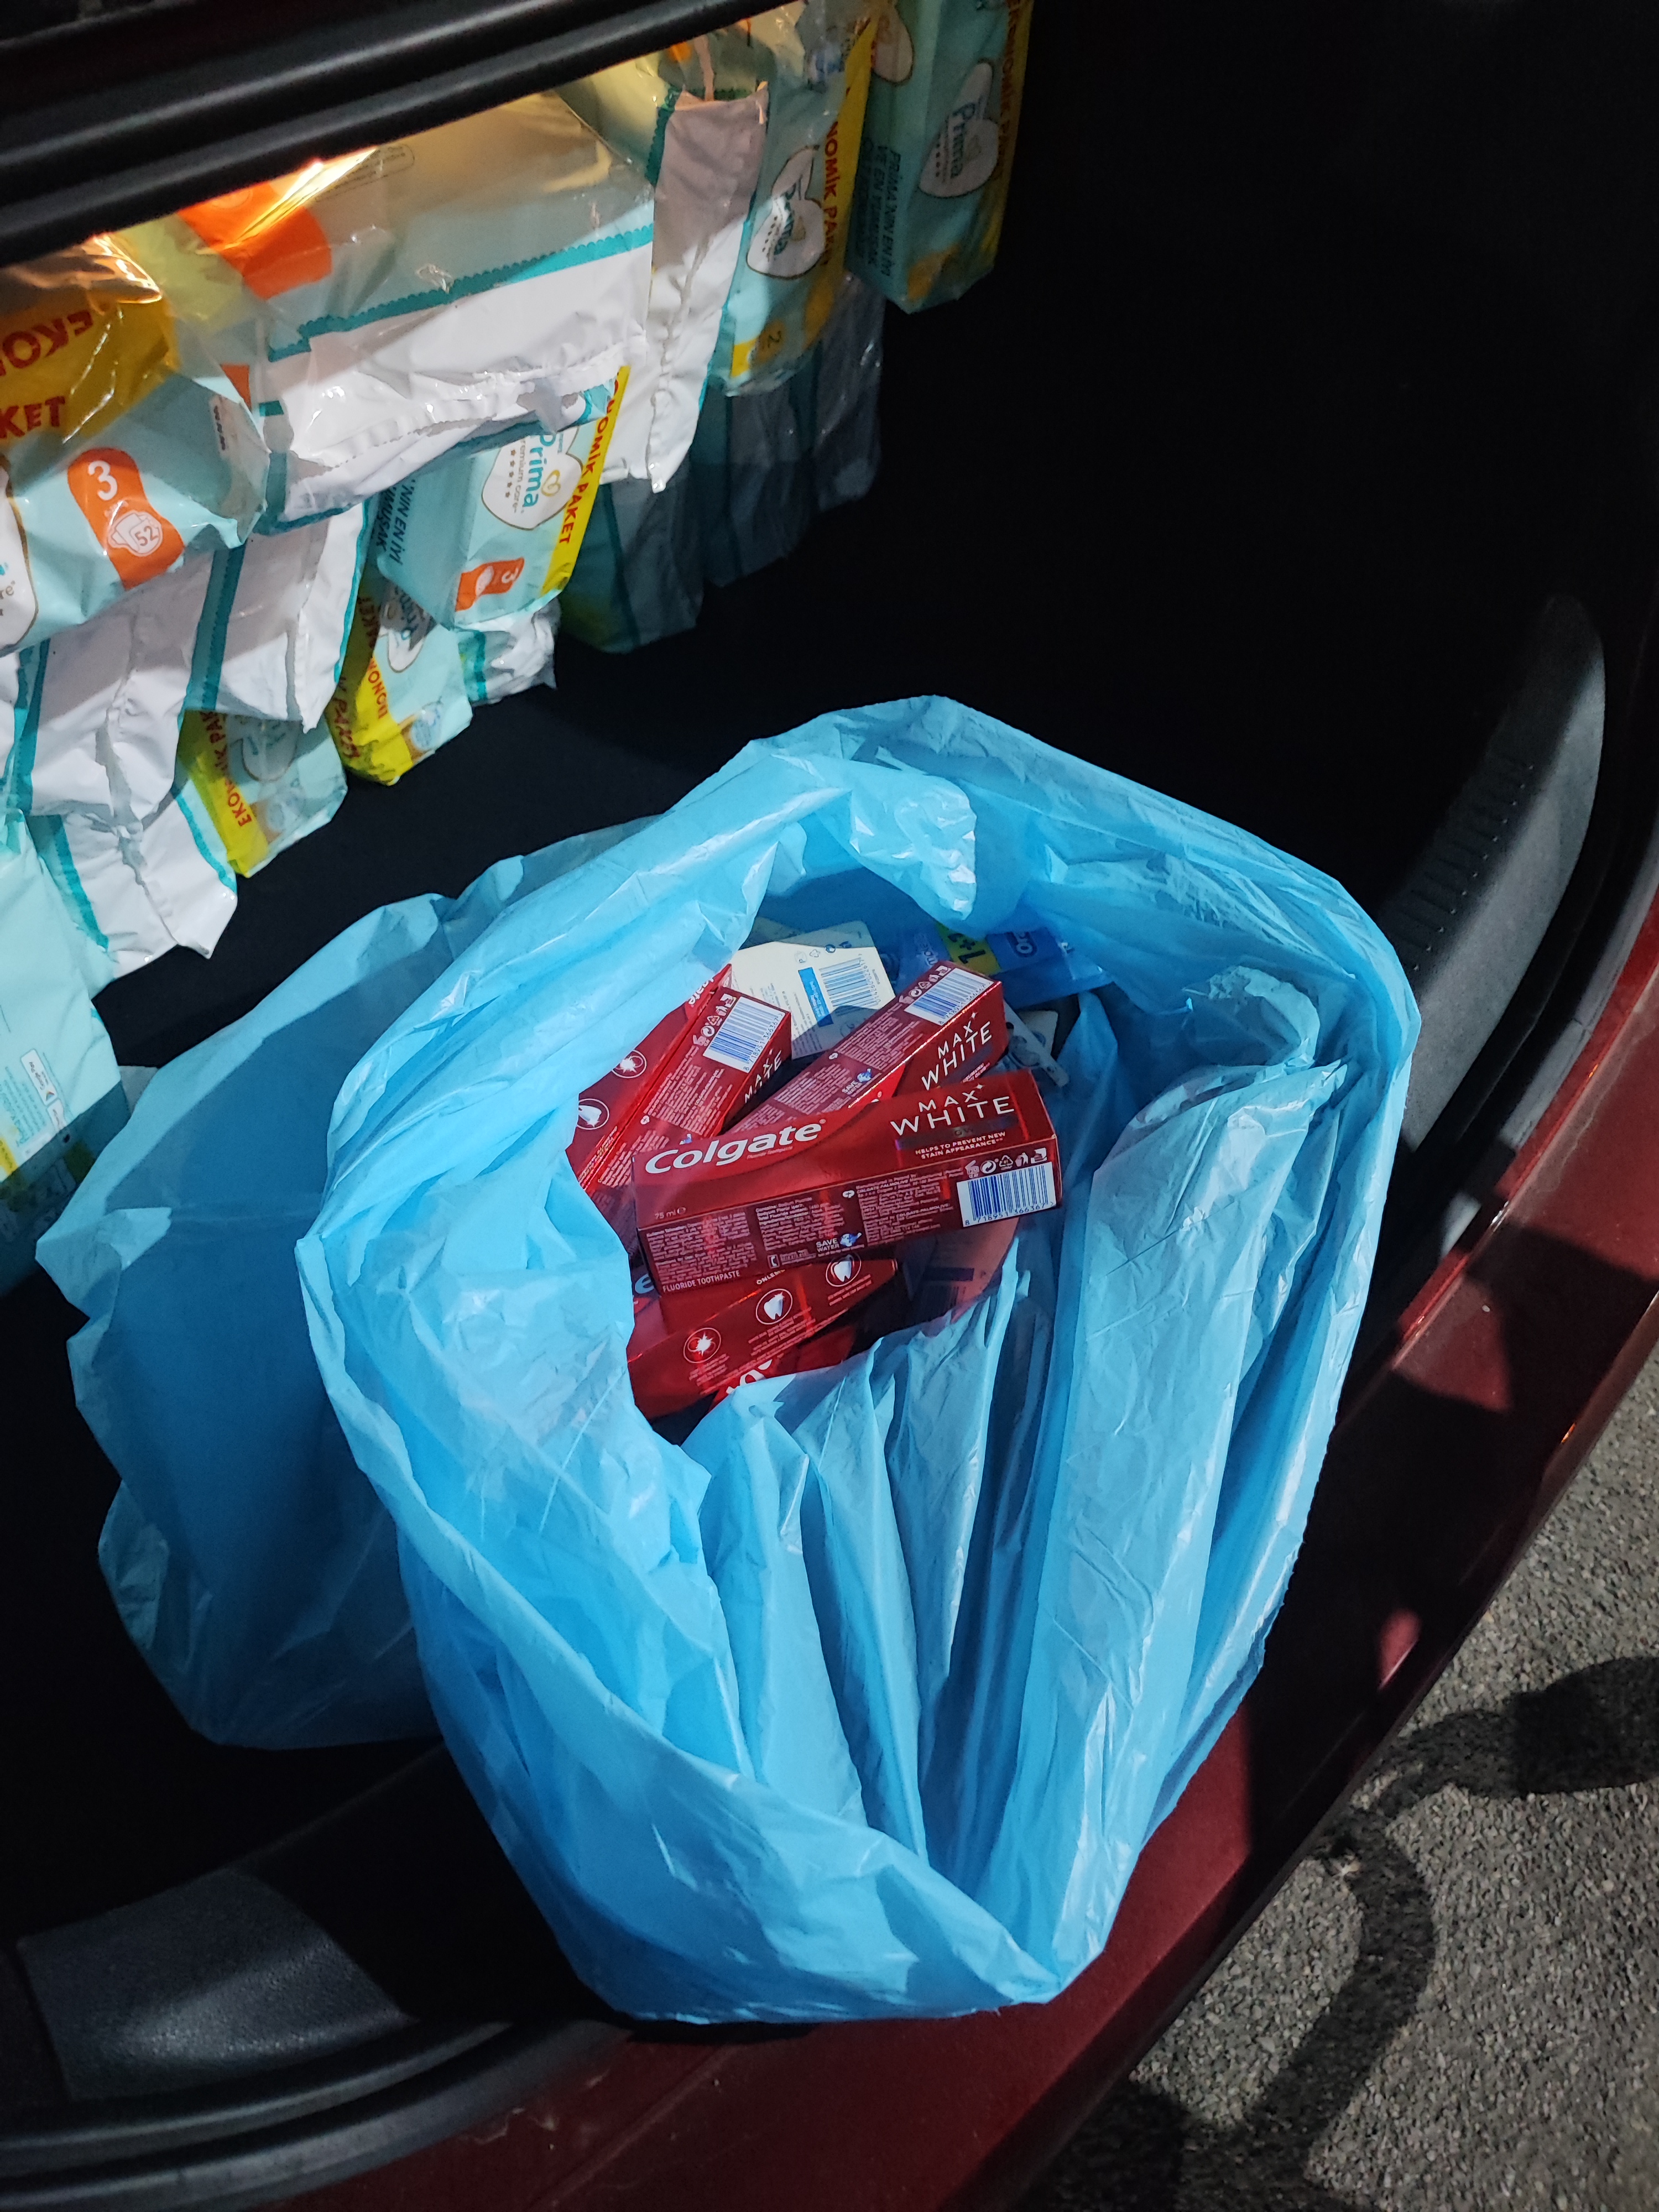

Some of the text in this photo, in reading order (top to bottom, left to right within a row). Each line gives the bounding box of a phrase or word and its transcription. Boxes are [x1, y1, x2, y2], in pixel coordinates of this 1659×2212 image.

[88, 460, 118, 500] 3
[560, 482, 589, 545] PAKET
[135, 525, 159, 546] 52
[938, 1020, 973, 1059] MAX
[921, 1021, 992, 1091] WHITE
[842, 1080, 858, 1093] SAVE
[919, 1090, 979, 1112] MAX
[890, 1096, 1015, 1136] WHITE
[645, 1123, 822, 1173] Colgate
[915, 1131, 1006, 1155] HELPS TO PREVENT NEW
[921, 1150, 943, 1160] STAIN
[666, 1208, 676, 1217] ml
[977, 1209, 1009, 1223] 718951
[1013, 1203, 1045, 1215] 366367
[815, 1237, 838, 1248] SAVE
[816, 1243, 840, 1253] WATER
[662, 1279, 697, 1292] FLUORIDE
[697, 1270, 740, 1286] TOOTHPASTE
